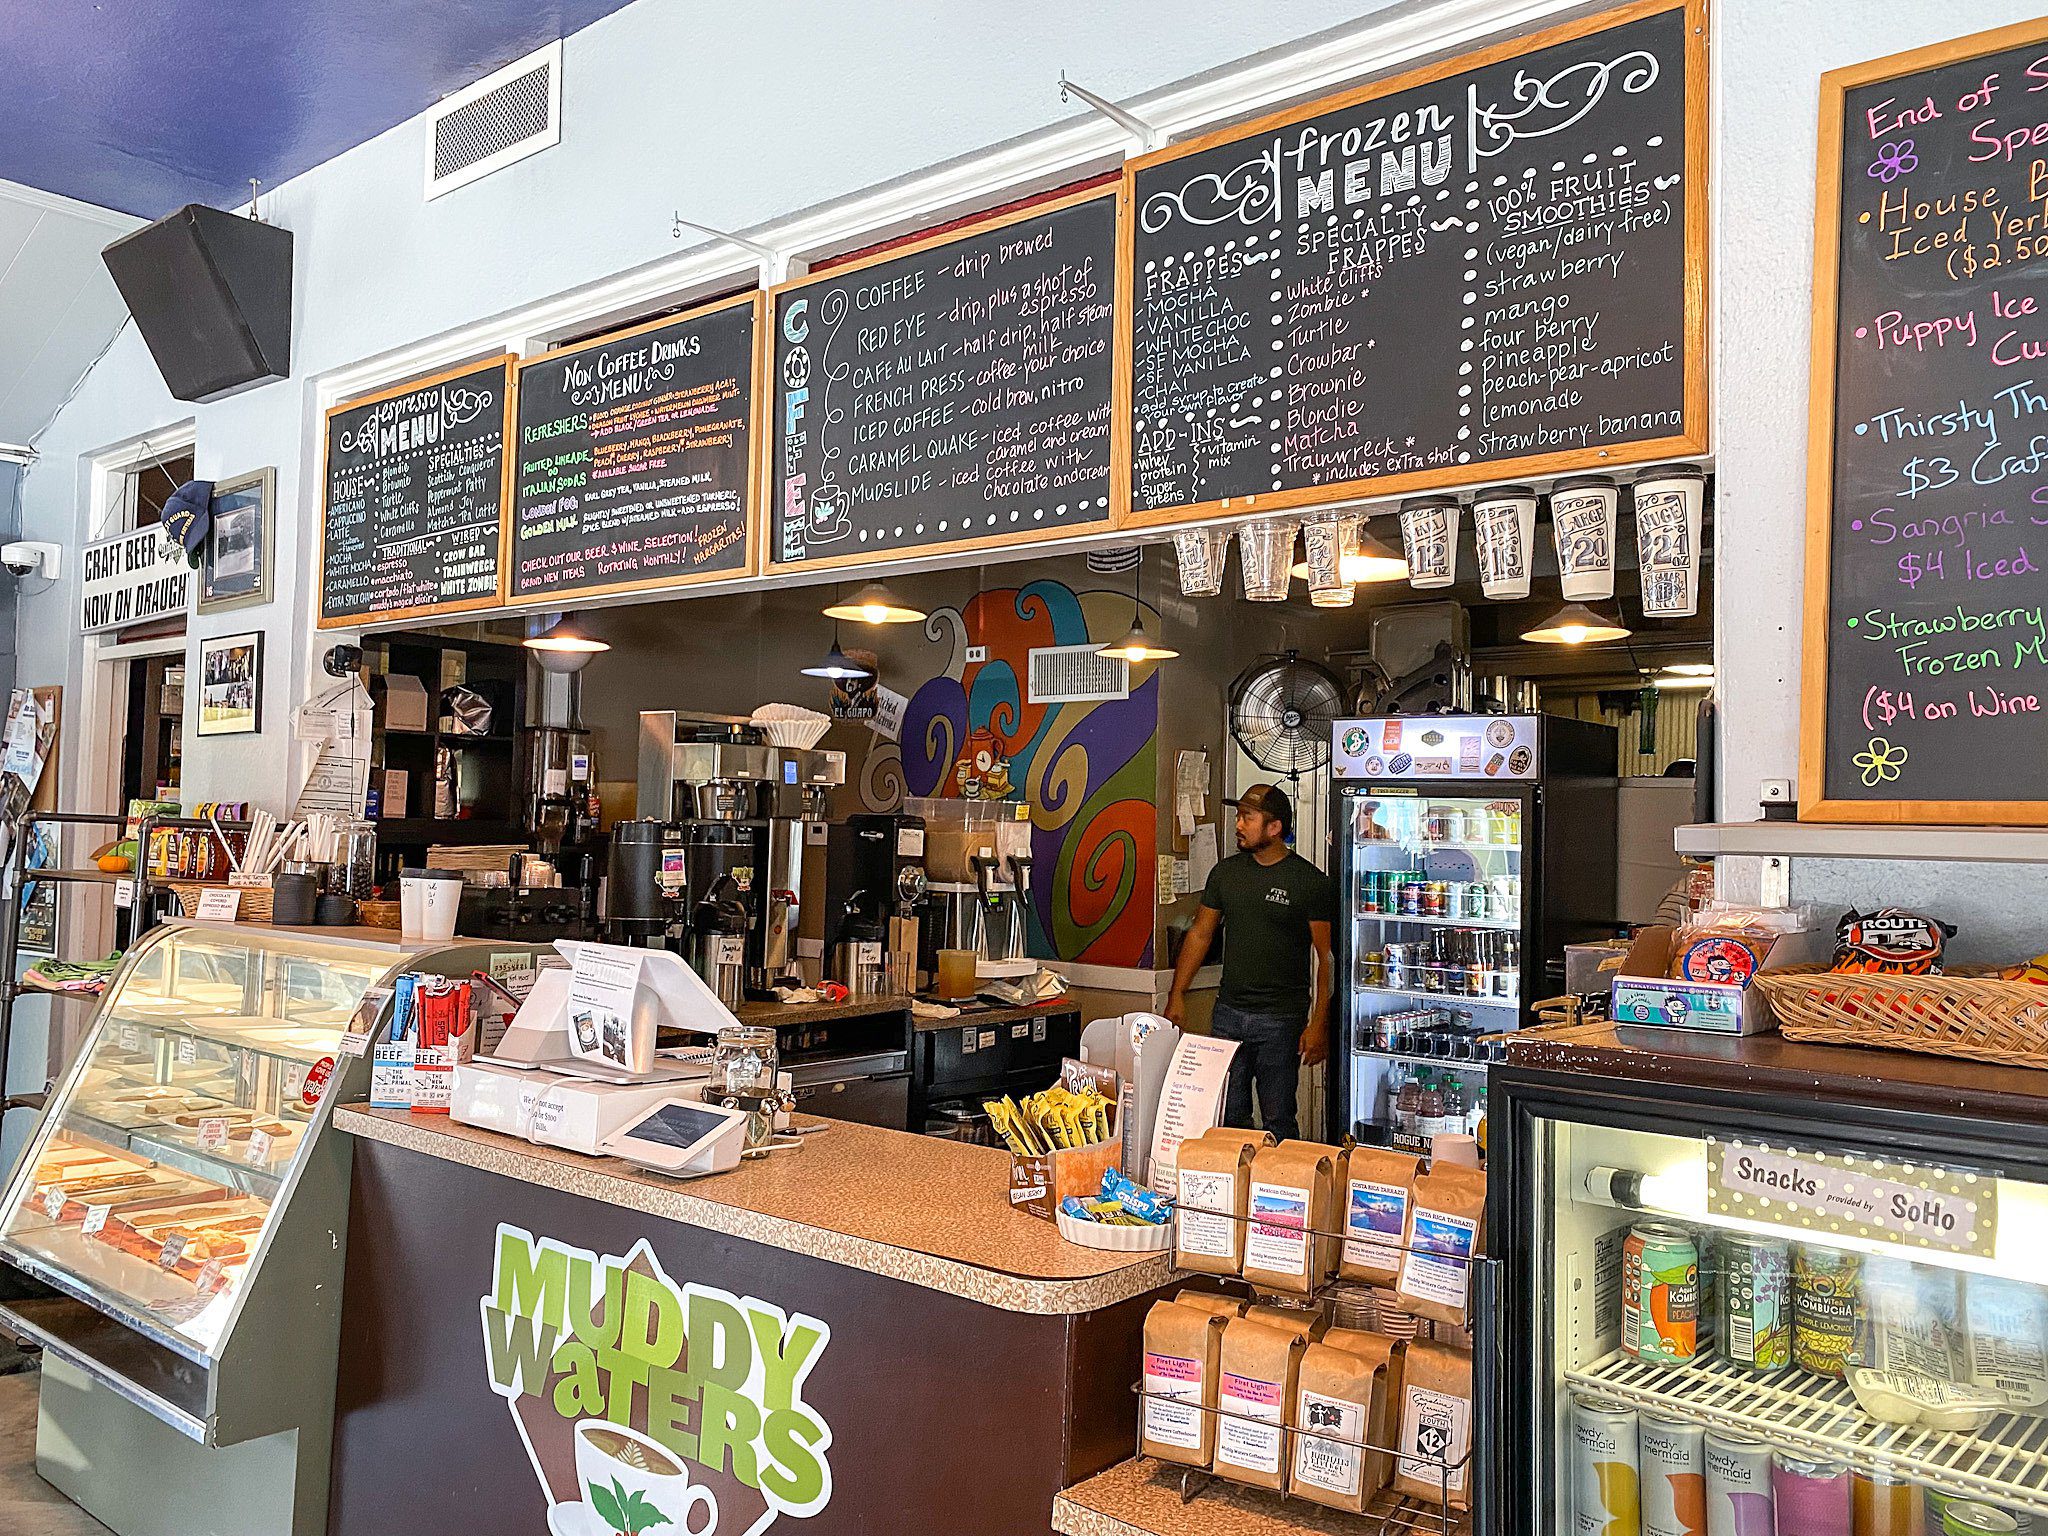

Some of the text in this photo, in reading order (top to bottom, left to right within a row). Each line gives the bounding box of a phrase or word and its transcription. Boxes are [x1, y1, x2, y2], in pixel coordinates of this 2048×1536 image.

[1867, 73, 2000, 140] End of
[1284, 105, 1454, 171] frozen
[1297, 134, 1452, 219] MENU
[1488, 160, 1637, 222] 100% FRUIT
[1502, 181, 1651, 238] SMOOTHIES
[1618, 201, 1671, 233] free)
[1879, 186, 2000, 232] House
[1296, 205, 1427, 255] SPECIALTY
[1885, 218, 1968, 260] Iced
[1327, 228, 1427, 274] FRAPPES
[856, 227, 1053, 311] COFFEE brewed
[1144, 252, 1244, 301] FRAPPES
[1287, 264, 1384, 300] White Cliffs
[1484, 250, 1624, 298] strawberry
[858, 327, 888, 355] RED
[893, 313, 926, 345] EYE
[1074, 256, 1093, 284] of
[1019, 283, 1097, 321] espresso
[1147, 298, 1235, 334] VANILLA
[1148, 286, 1218, 318] MOCHA
[1288, 291, 1354, 325] Zombie
[1485, 294, 1570, 327] mango
[1145, 312, 1251, 353] WHITE CHOC
[1288, 318, 1350, 348] Turtle
[1479, 312, 1600, 353] four berry
[1875, 291, 2038, 352] Puppy Ice
[852, 302, 1112, 390] CAFE AU LAIT drip, half steam
[1023, 334, 1063, 363] milk
[1172, 336, 1239, 365] MOCHA
[1173, 346, 1251, 376] VANILLA
[1287, 344, 1364, 378] Crowbar
[1482, 337, 1598, 381] pineapple
[600, 373, 643, 403] MENU
[853, 338, 1106, 419] FRENCH PRESS choice
[1288, 366, 1367, 405] Brownie
[1482, 341, 1674, 403] peach-pear-apricot
[380, 390, 438, 424] espresso
[853, 378, 1084, 445] ICED COFFEE nitro
[1287, 397, 1363, 431] Blondie
[1482, 388, 1583, 427] lemonade
[1871, 399, 1998, 446] Thirsty
[380, 417, 439, 457] MENU
[849, 401, 1112, 476] CARAMEL QUAKE coffee with
[986, 424, 1109, 466] caramel and cream
[1138, 419, 1224, 455] ADD-INS
[1208, 438, 1260, 455] vitamin
[1284, 421, 1359, 455] Matcha
[428, 444, 484, 472] SPECIALTIES
[985, 459, 1037, 482] coffee
[1045, 449, 1093, 470] with
[1140, 456, 1230, 484] protein mix
[1282, 439, 1398, 474] Trainwreck
[1325, 444, 1459, 481] includes shot
[333, 476, 364, 502] HOUSE
[1896, 456, 1959, 499] $3
[1147, 490, 1185, 509] greens
[1560, 507, 1605, 535] LARGE
[1641, 503, 1685, 536] HUGE
[1870, 507, 2014, 547] Sangria
[85, 533, 155, 582] CRAFT BEER
[377, 560, 407, 574] espresso
[1574, 537, 1607, 567] 20
[1654, 534, 1687, 565] 24
[375, 571, 413, 584] macchiato
[1898, 547, 2039, 589] $4 Iced
[84, 572, 190, 628] NOW ON DRAUGH
[1863, 606, 2047, 645] Strawberry
[1895, 641, 2001, 676] Frozen
[1861, 685, 2040, 731] ($4 on Wine
[1862, 917, 1928, 930] ROUTE
[374, 1050, 402, 1060] BEEF
[415, 1055, 442, 1064] BEEF
[547, 1101, 564, 1112] accept
[1394, 1133, 1421, 1147] ROGUE
[1352, 1182, 1367, 1191] COSTA
[1738, 1156, 1955, 1231] Snacks provided by SoHo
[1415, 1209, 1432, 1219] COSTA
[1432, 1213, 1446, 1222] RICA
[497, 1233, 822, 1411] MUDDY
[1796, 1294, 1853, 1316] KOMBUCHA
[1157, 1357, 1189, 1368] First Light
[1234, 1378, 1268, 1391] First Light
[1421, 1415, 1447, 1428] SOUTH
[1424, 1432, 1441, 1448] 12
[1644, 1434, 1675, 1452] rowdy
[1644, 1443, 1690, 1461] mermaid
